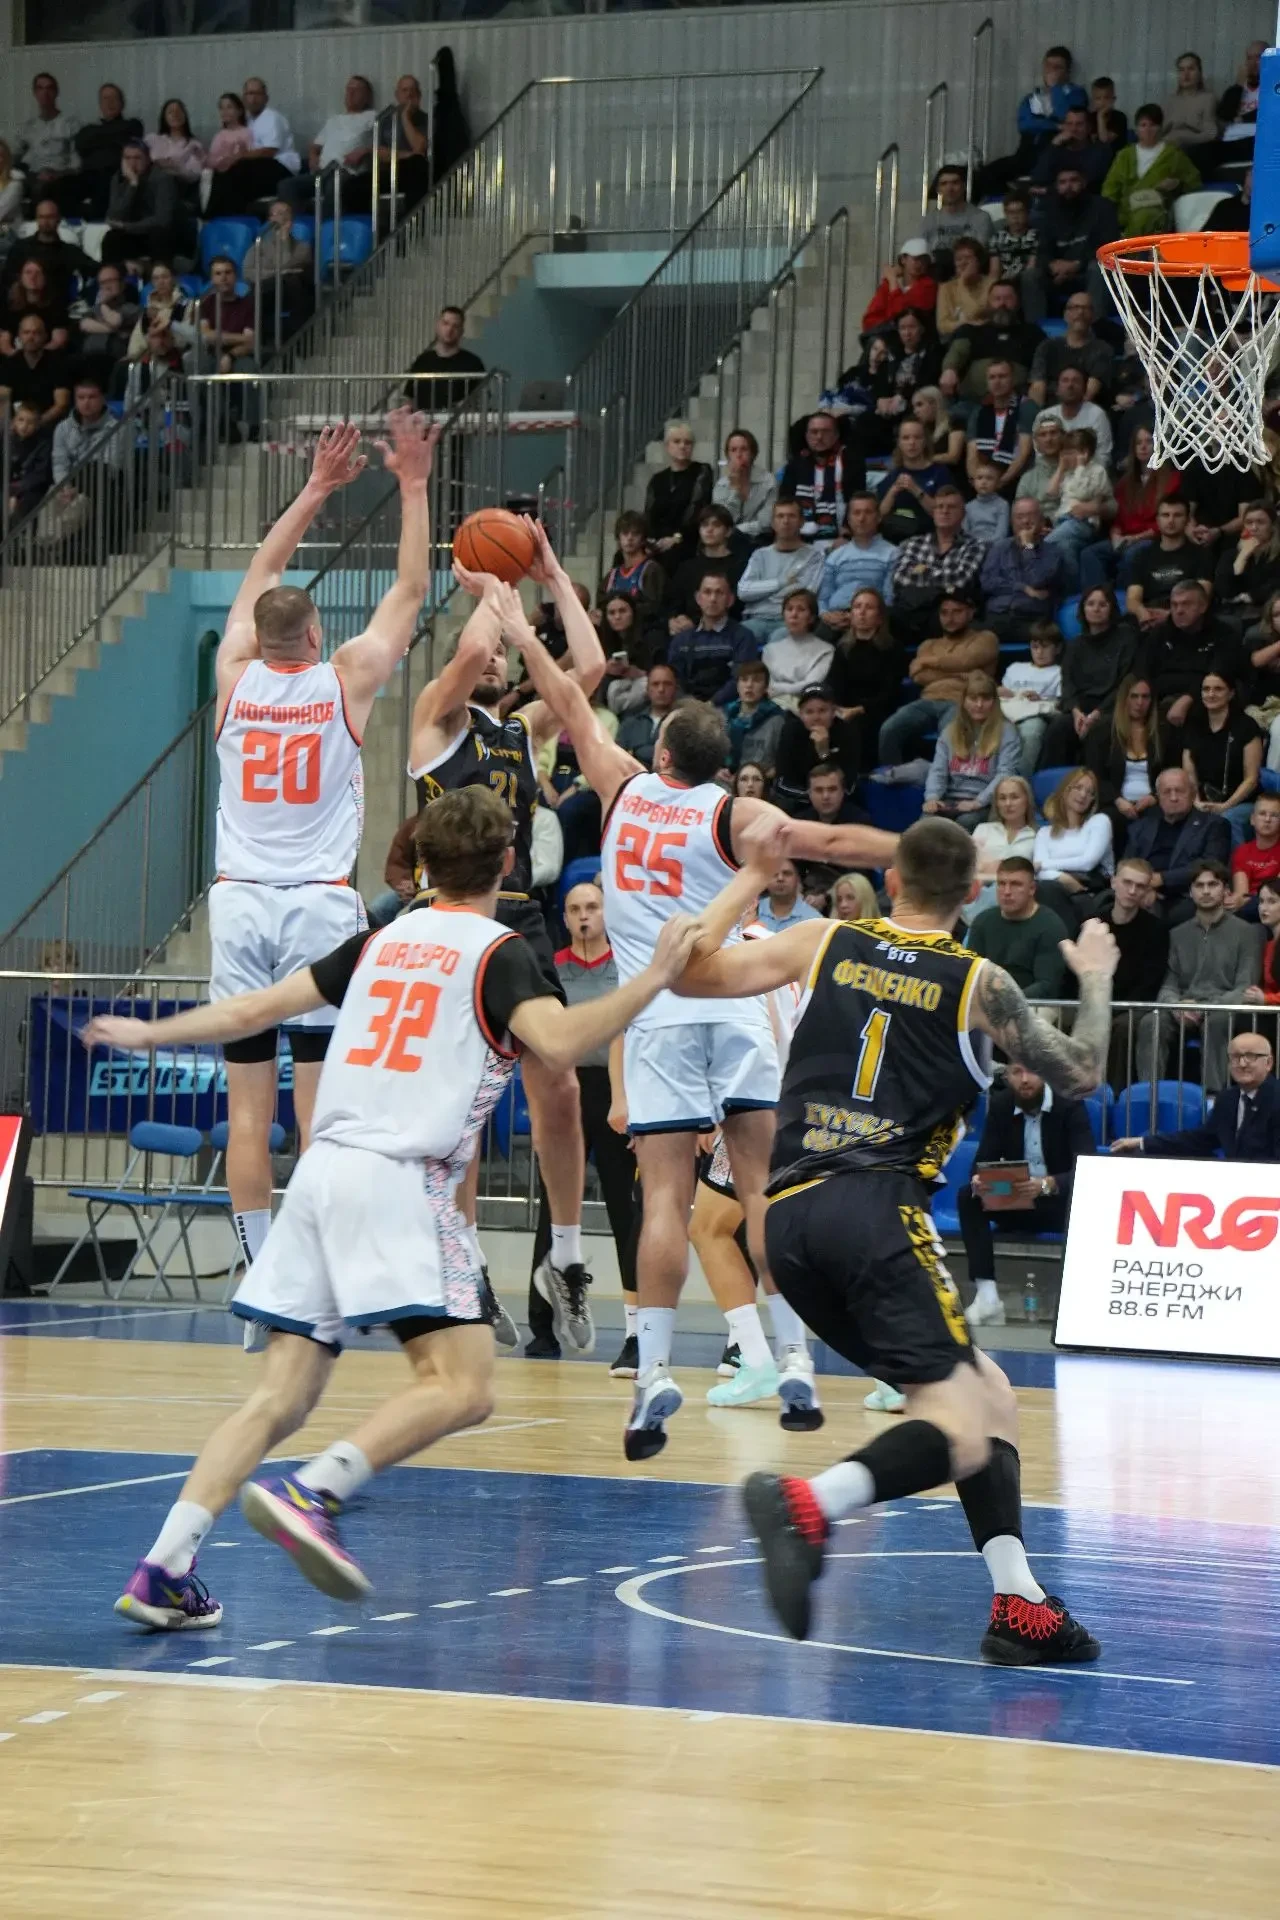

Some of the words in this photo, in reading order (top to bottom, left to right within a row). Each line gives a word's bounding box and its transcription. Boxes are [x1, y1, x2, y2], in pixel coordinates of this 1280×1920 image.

[242, 730, 321, 805] 20
[489, 770, 518, 808] 21
[616, 822, 688, 898] 25
[832, 959, 943, 1013] ФЕЩЕНКО
[344, 979, 443, 1073] 32
[852, 1007, 892, 1102] 1
[1116, 1190, 1280, 1252] NRG
[1110, 1279, 1243, 1302] ЭНЕРДЖИ
[1112, 1259, 1204, 1279] РАДИО
[1108, 1300, 1160, 1318] 88.6
[1166, 1303, 1205, 1320] FM
